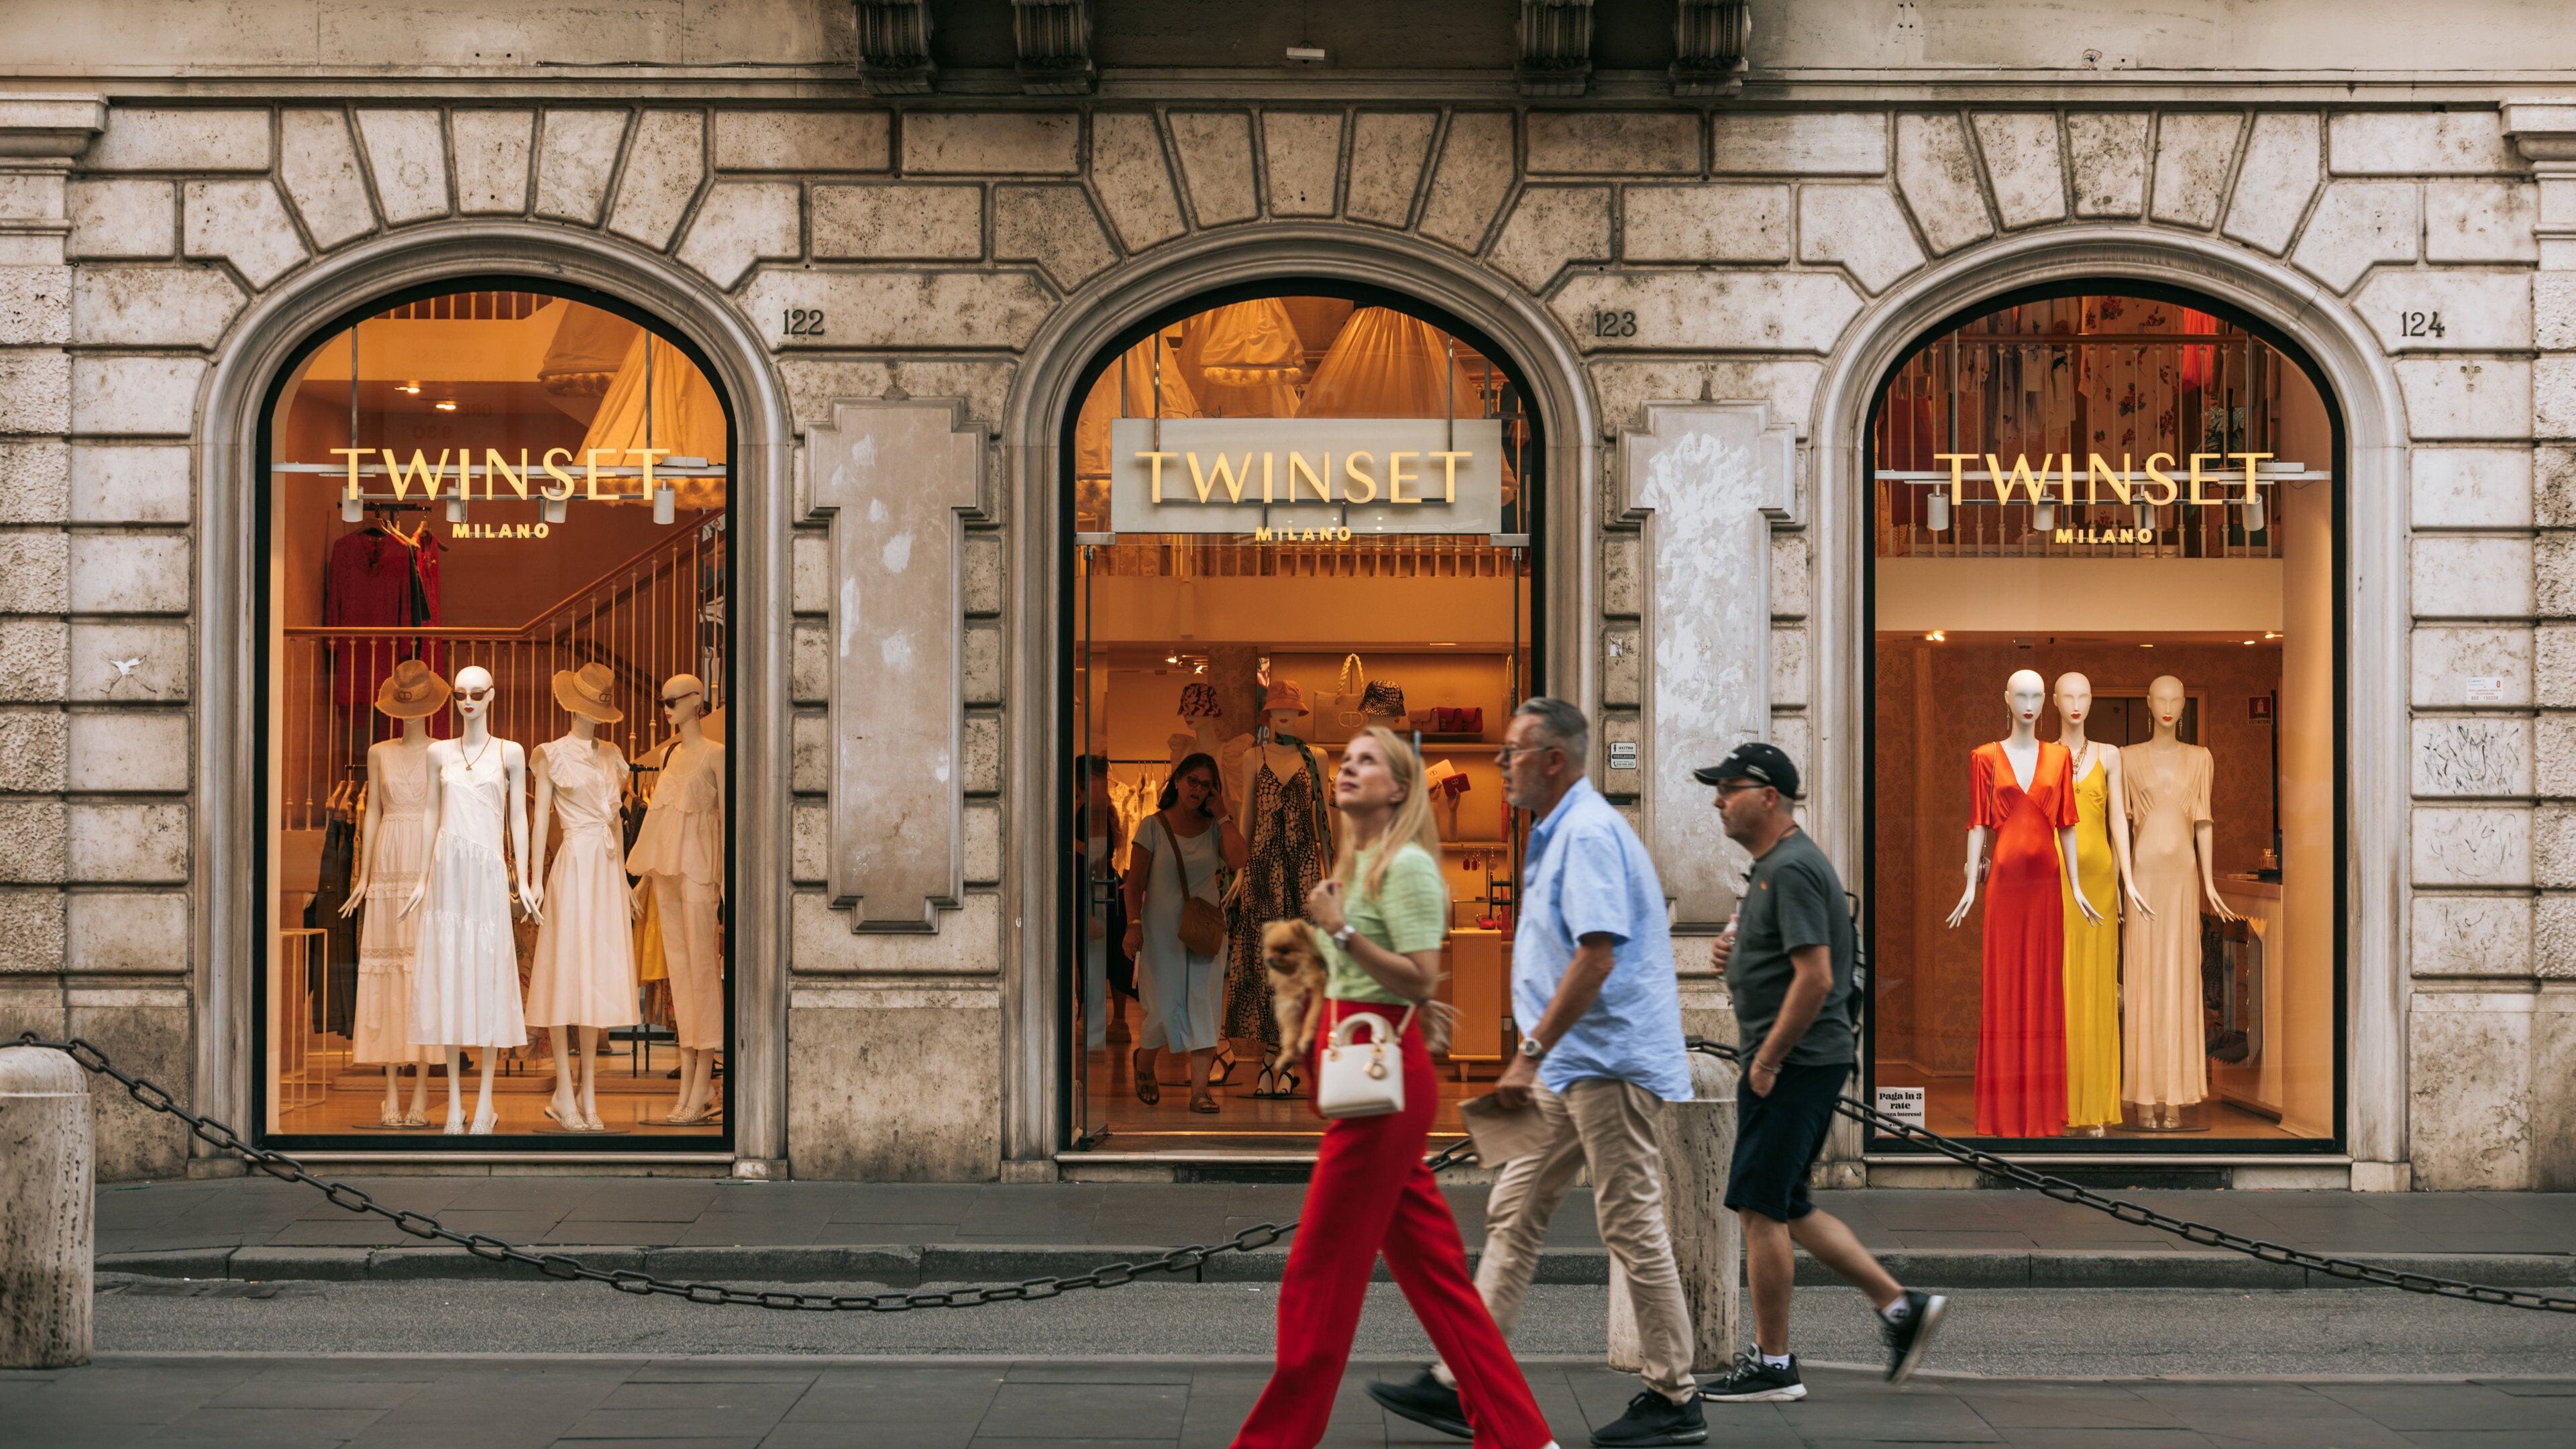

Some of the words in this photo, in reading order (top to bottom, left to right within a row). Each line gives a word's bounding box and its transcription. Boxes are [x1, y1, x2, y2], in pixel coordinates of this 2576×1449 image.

[783, 309, 824, 335] 122
[1595, 311, 1637, 337] 123
[2402, 311, 2445, 337] 124
[330, 448, 670, 501] TWINSET
[1135, 451, 1472, 504] TWINSET
[1934, 452, 2273, 506] TWINSET
[452, 523, 549, 539] MILANO
[1255, 526, 1352, 541] MILANO
[2055, 528, 2153, 543] MILANO
[1879, 1092, 1903, 1100] Paga
